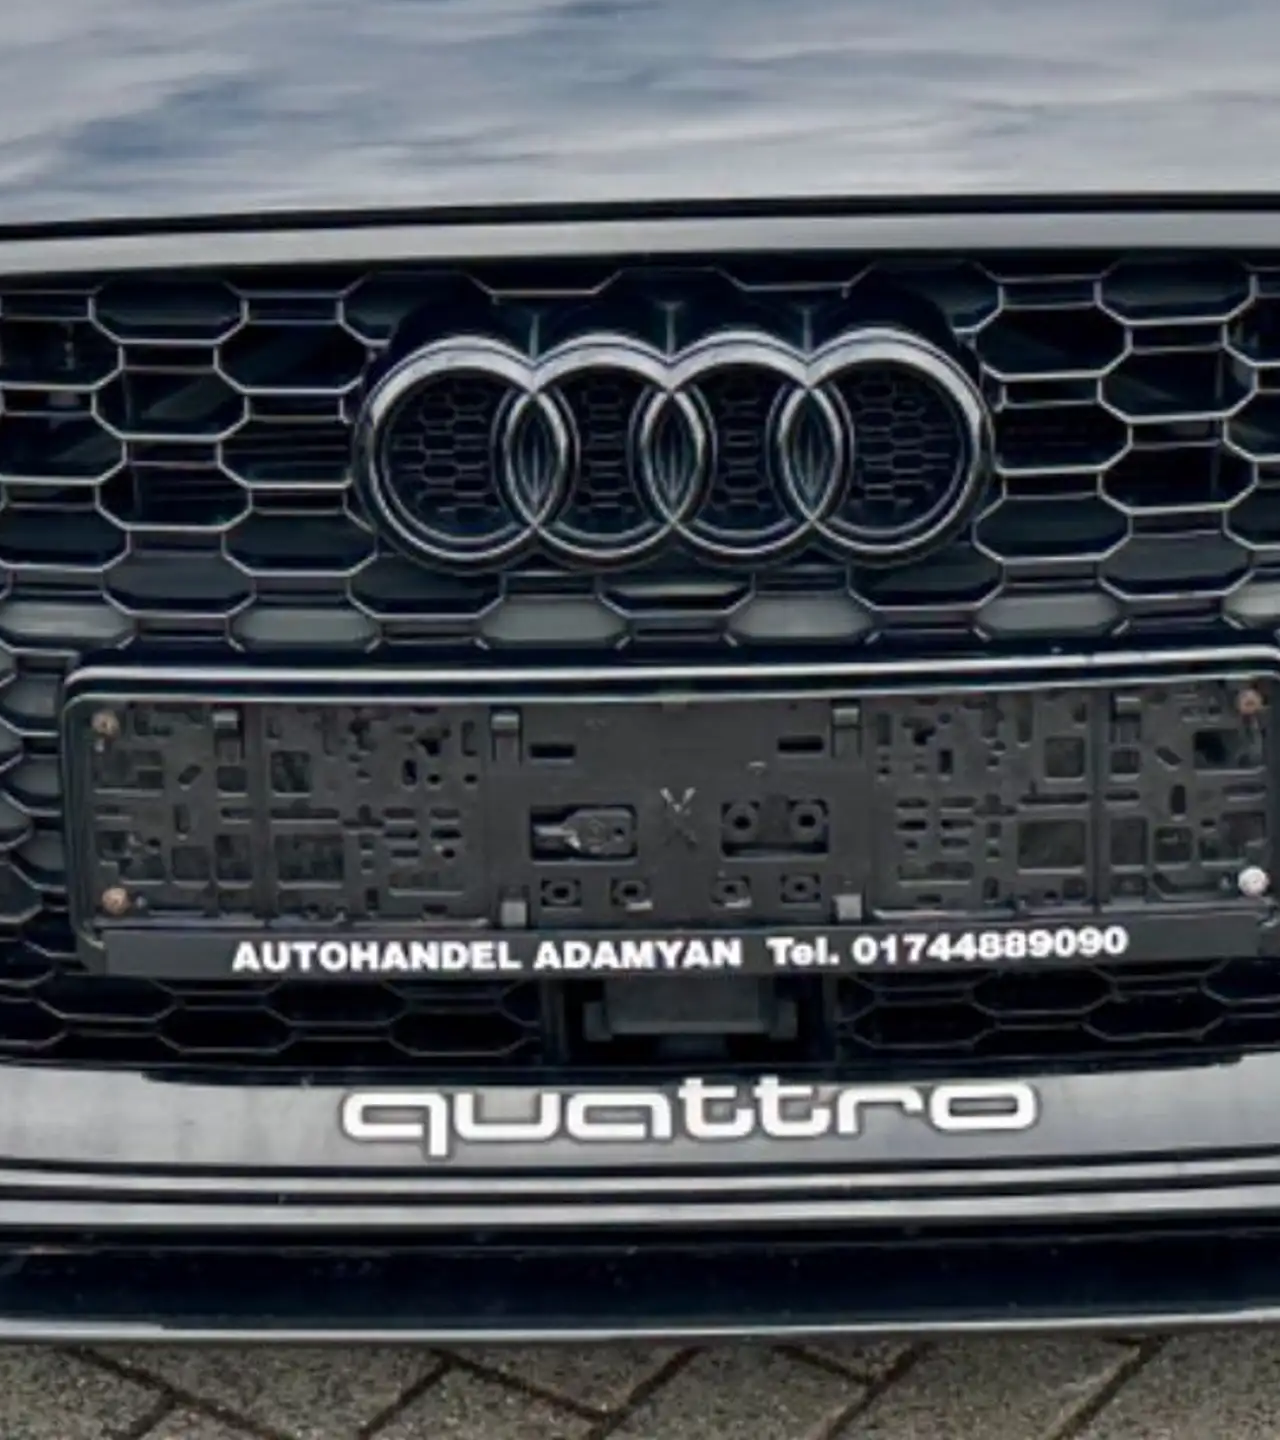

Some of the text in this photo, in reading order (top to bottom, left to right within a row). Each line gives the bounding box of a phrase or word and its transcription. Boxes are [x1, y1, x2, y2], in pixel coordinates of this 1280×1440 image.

[232, 926, 1130, 972] AUTOHANDEL ADAMYAN Tel. 01744889090
[341, 1076, 1038, 1157] quattro
